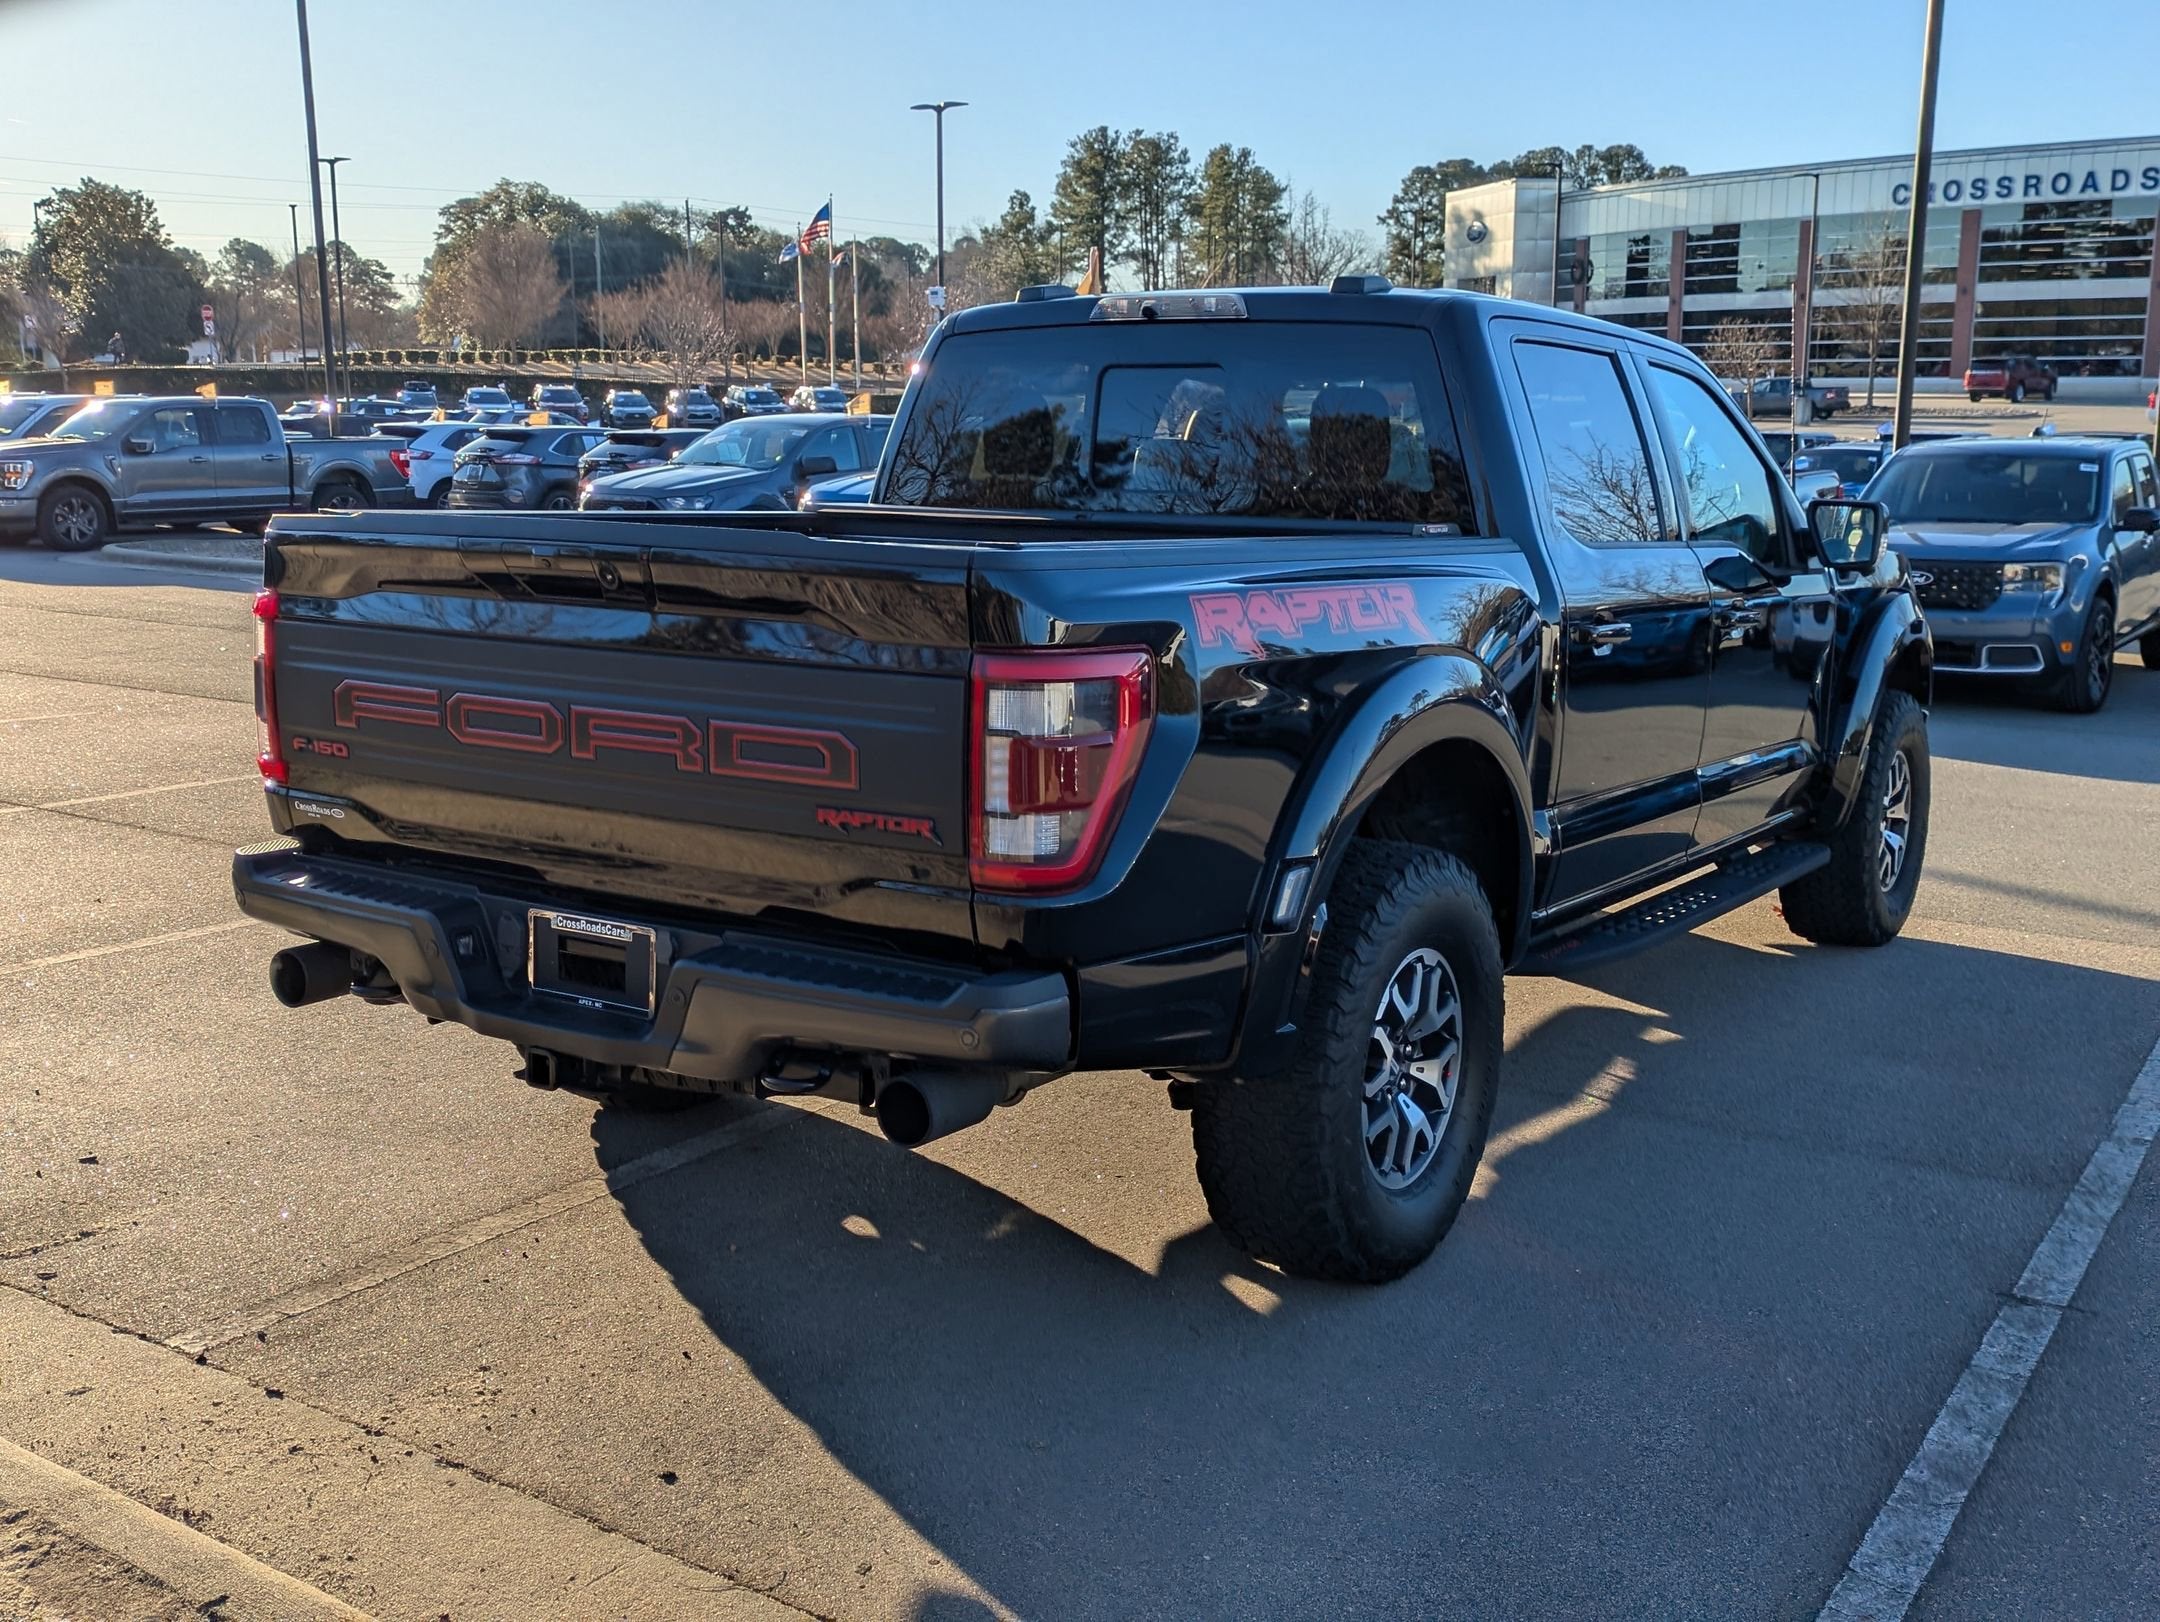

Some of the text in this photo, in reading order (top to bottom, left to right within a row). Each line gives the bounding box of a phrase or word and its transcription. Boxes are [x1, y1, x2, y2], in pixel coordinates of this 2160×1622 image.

[1891, 166, 2160, 206] COSSROADS
[1189, 583, 1436, 661] RAPTOR
[333, 679, 860, 790] FORD
[815, 806, 943, 847] RAPTOR
